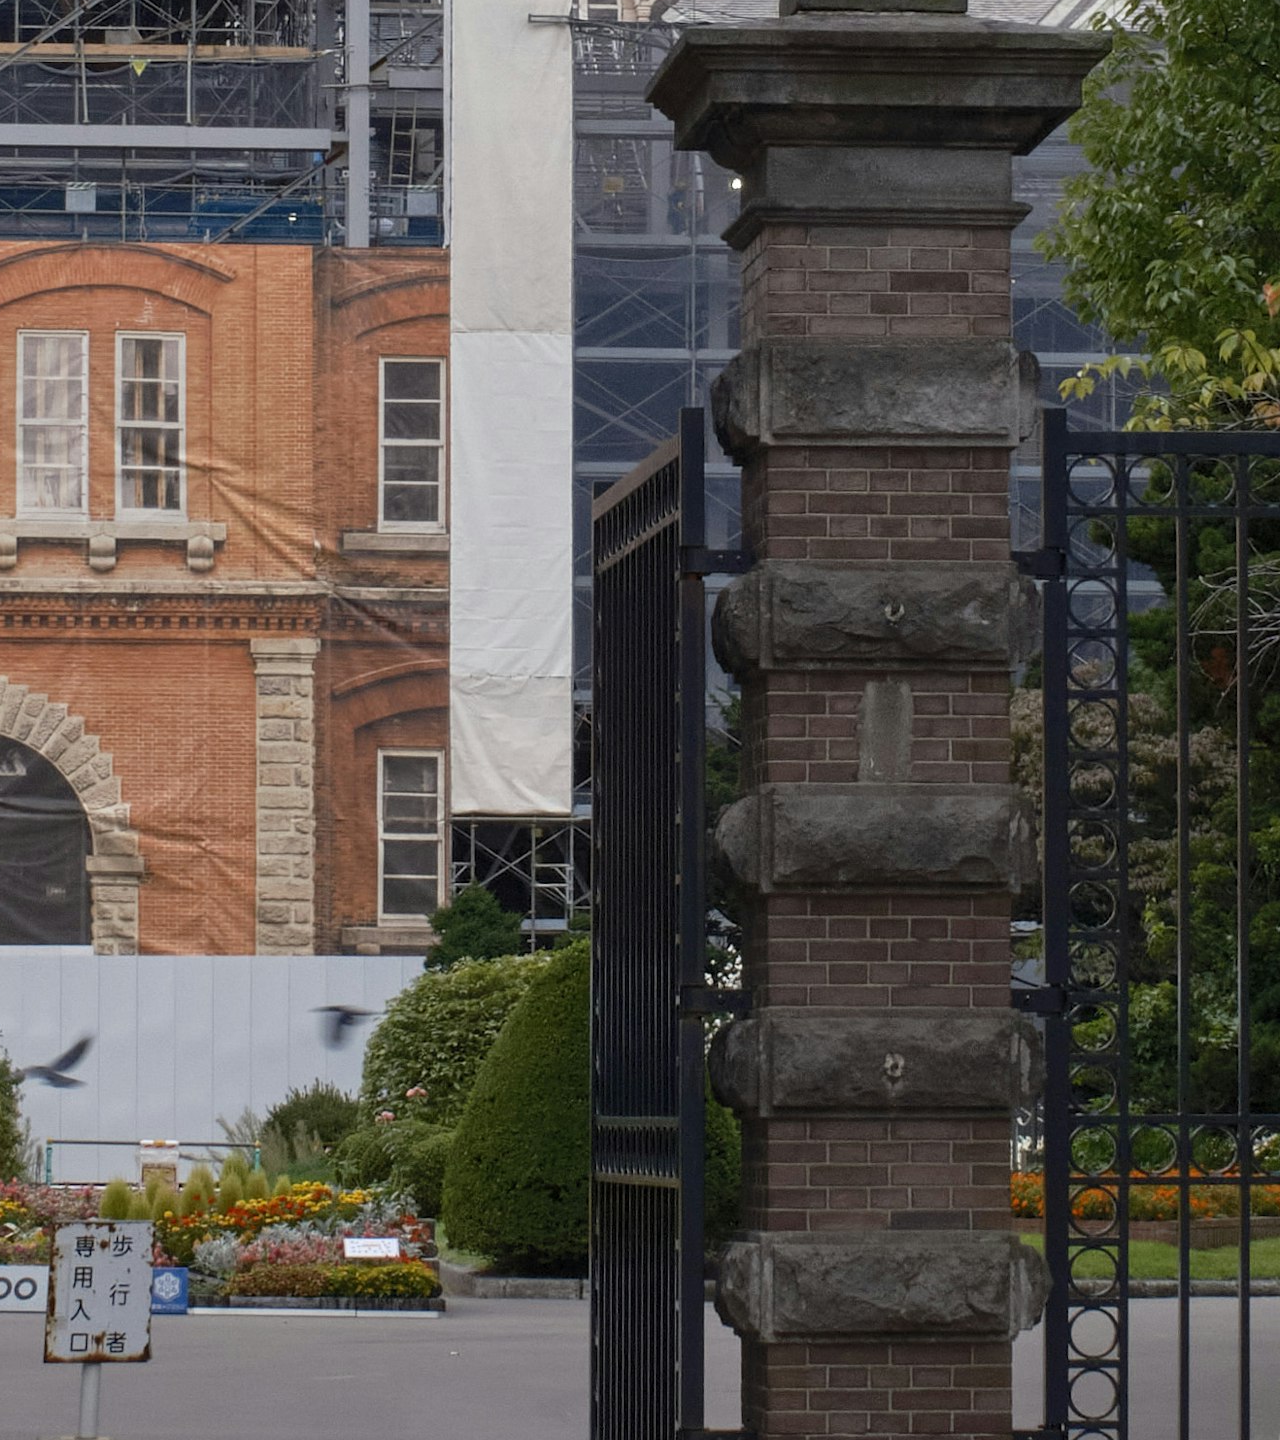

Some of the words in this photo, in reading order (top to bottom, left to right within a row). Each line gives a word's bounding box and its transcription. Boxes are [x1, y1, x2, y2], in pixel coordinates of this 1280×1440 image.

[70, 1235, 96, 1352] 専用入口
[105, 1234, 133, 1353] 歩行者
